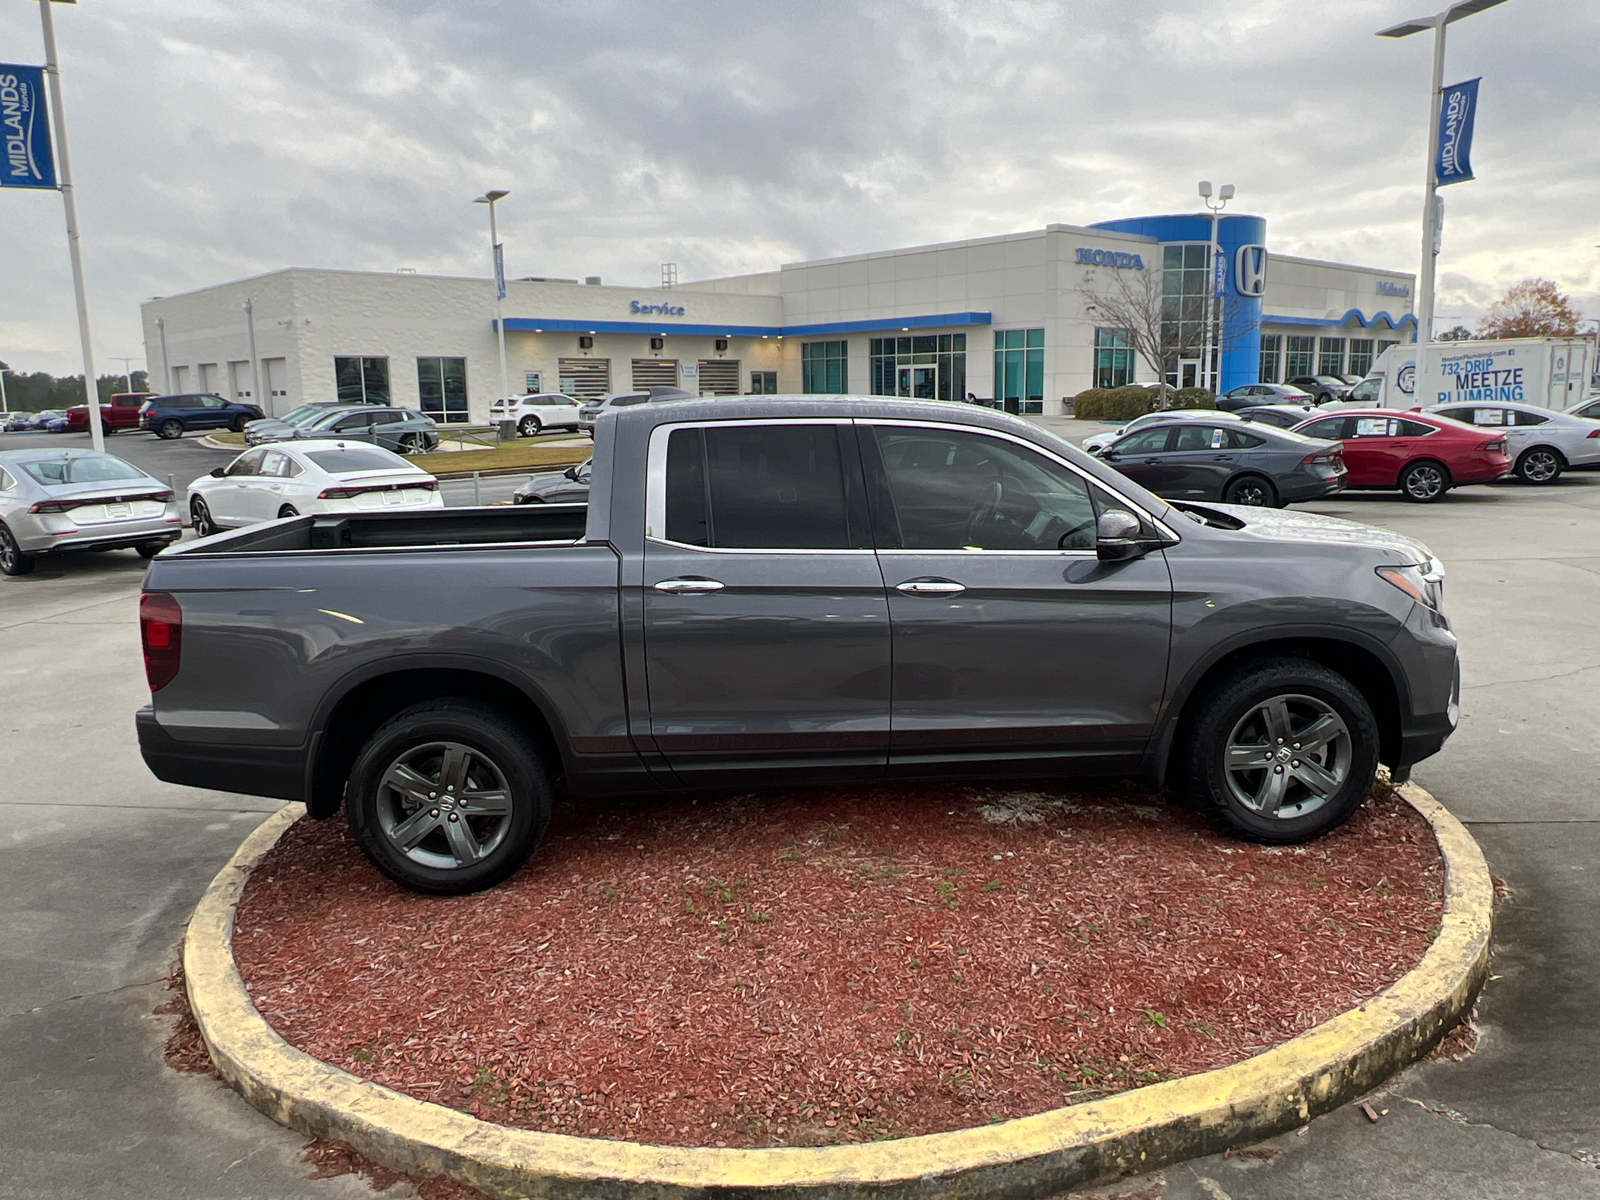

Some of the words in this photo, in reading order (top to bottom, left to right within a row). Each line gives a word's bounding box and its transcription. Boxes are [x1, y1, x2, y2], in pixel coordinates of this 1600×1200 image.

[20, 82, 30, 112] Honda
[1457, 95, 1466, 120] Honda
[0, 74, 29, 176] MIDLANDS
[1442, 91, 1461, 176] MIDLANDS
[1075, 247, 1145, 270] HONDA
[631, 300, 685, 316] Service
[1440, 358, 1494, 376] 732-DRIP
[1441, 350, 1507, 363] MeetzePlumbing.com
[1456, 368, 1523, 390] MEETZE
[1437, 385, 1524, 403] PLUMBING
